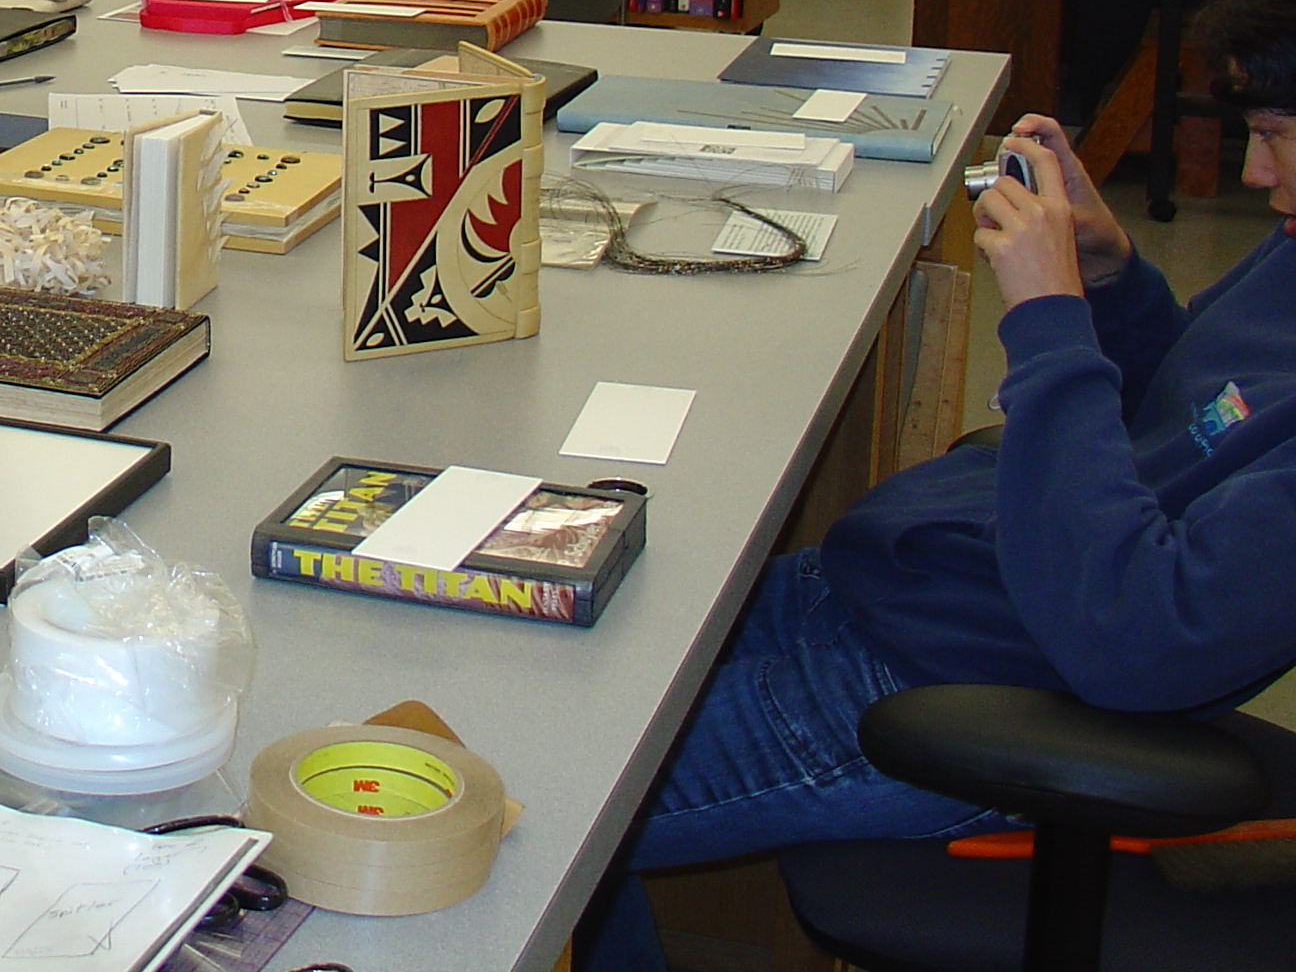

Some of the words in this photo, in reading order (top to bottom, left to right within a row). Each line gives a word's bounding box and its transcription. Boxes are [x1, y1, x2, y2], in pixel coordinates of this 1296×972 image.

[312, 471, 397, 533] TITAN
[292, 548, 384, 587] THE
[394, 562, 532, 609] TITAN
[353, 779, 381, 793] 3M
